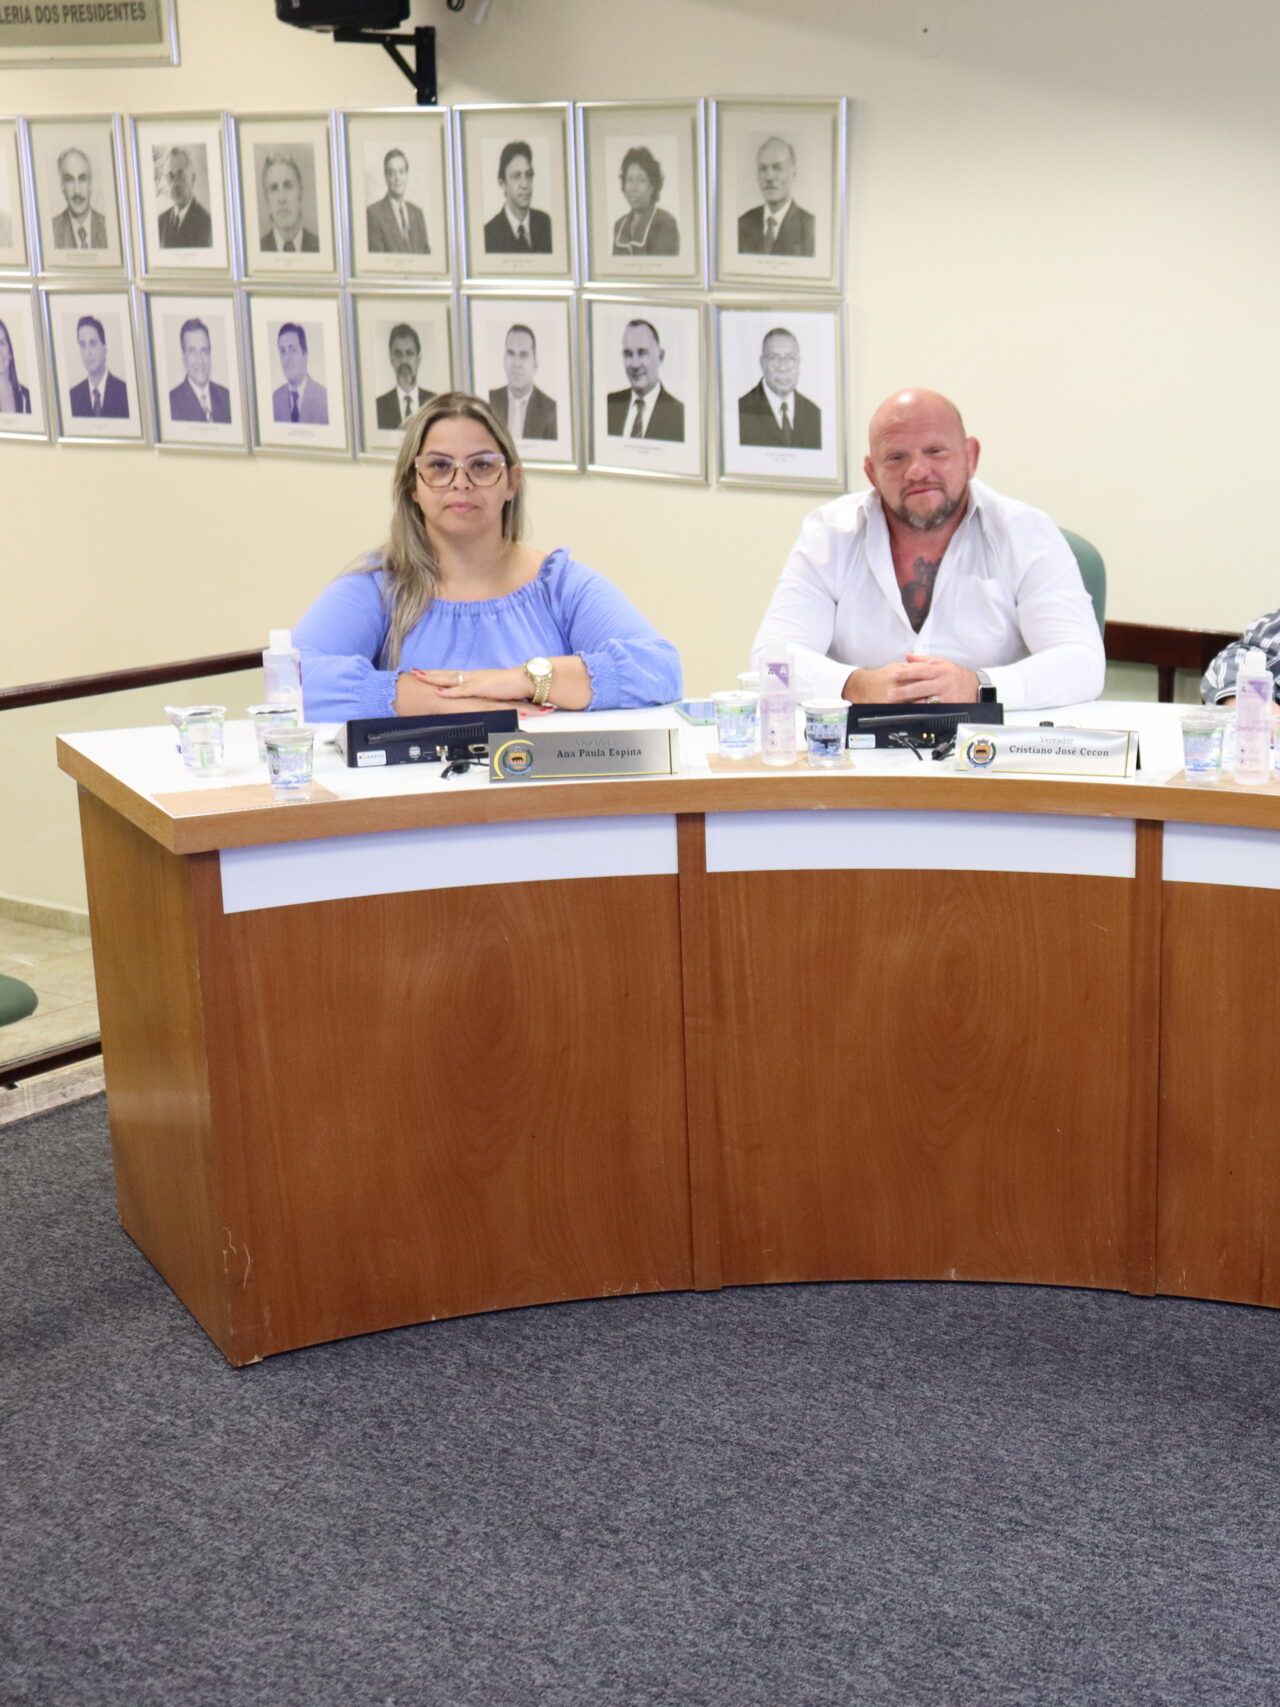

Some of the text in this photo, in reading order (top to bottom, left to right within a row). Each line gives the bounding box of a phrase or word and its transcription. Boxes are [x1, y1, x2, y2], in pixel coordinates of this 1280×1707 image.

[34, 4, 60, 24] DOS
[62, 2, 146, 23] PRESIDENTES
[556, 747, 642, 759] Ana Paula Espina
[1009, 745, 1109, 757] Cristiano José Cecon
